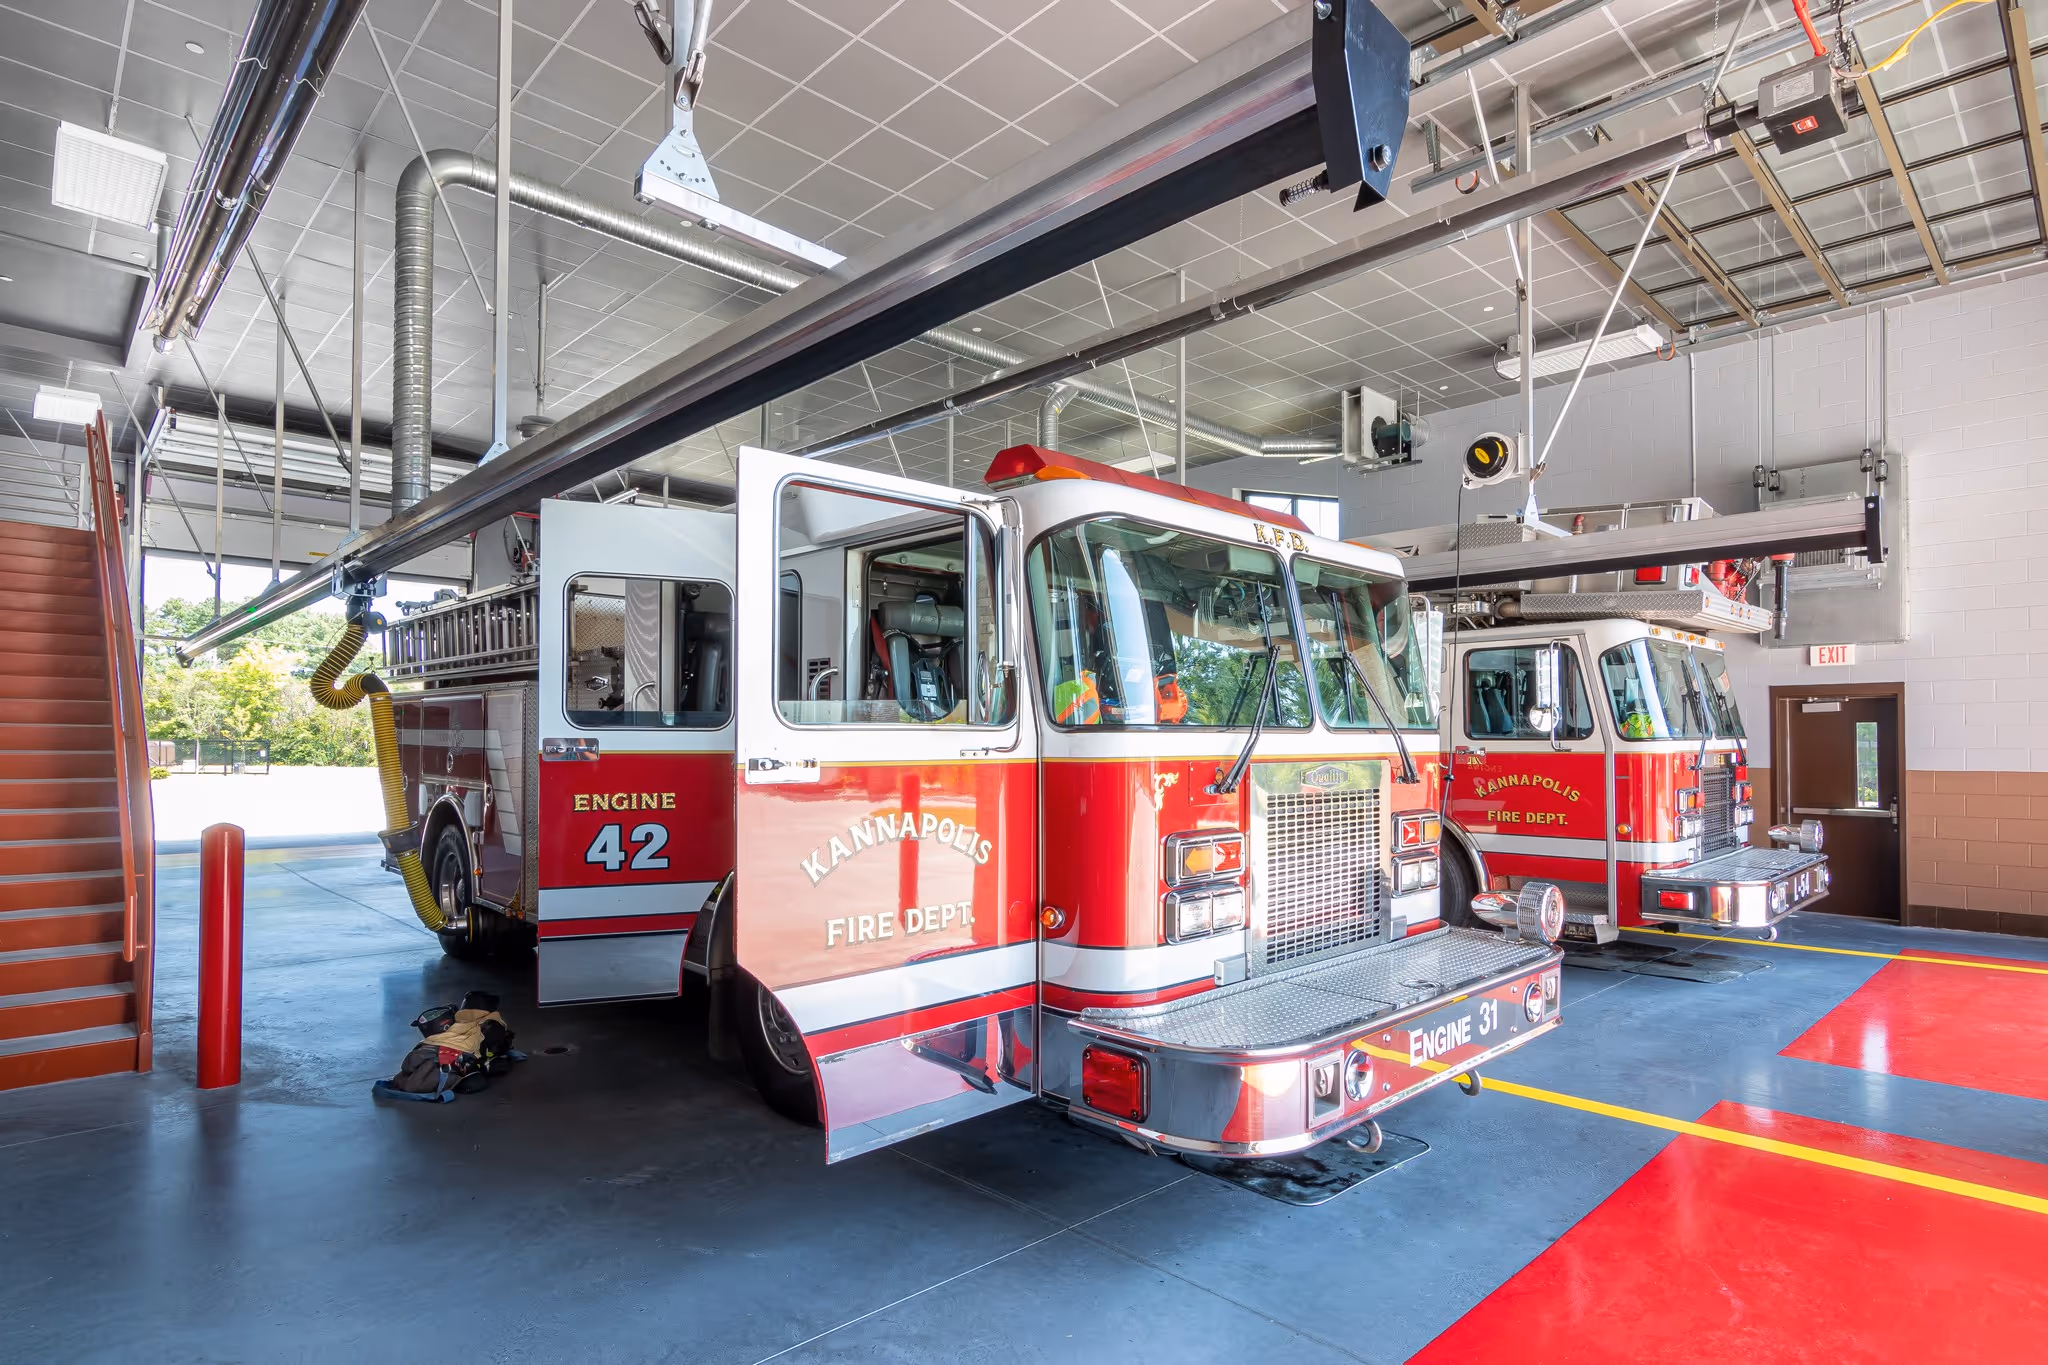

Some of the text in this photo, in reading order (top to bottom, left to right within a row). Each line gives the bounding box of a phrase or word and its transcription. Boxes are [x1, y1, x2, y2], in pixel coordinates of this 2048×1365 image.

[1254, 523, 1309, 553] K.F.D.
[1819, 646, 1847, 664] EXIT
[574, 792, 676, 812] ENGINE
[1475, 774, 1581, 802] KANNAPOLIS
[1487, 810, 1568, 825] FIRE DEPT.
[585, 822, 669, 872] 42
[800, 812, 993, 888] KANNAPOLIS
[1793, 871, 1810, 901] L-54
[825, 901, 976, 949] FIRE DEPT.
[1408, 998, 1498, 1067] ENGINE 31
